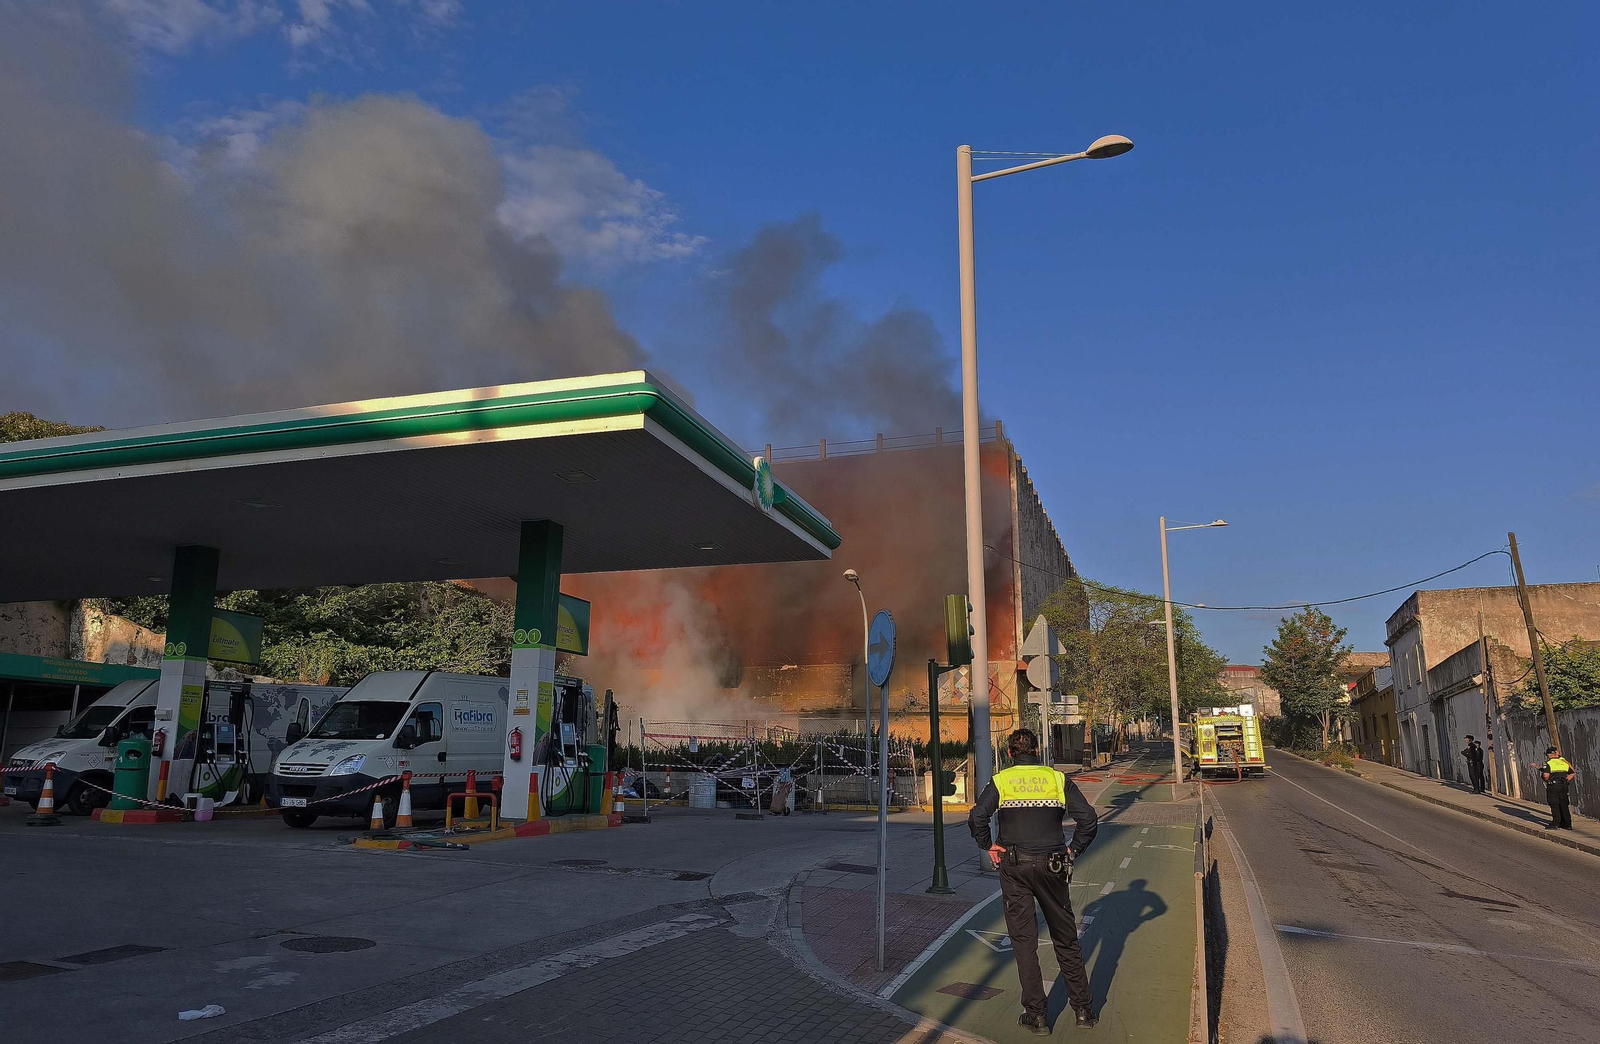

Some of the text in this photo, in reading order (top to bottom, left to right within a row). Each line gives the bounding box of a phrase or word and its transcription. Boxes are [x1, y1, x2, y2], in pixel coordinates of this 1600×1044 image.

[212, 635, 240, 647] Ultimate
[517, 632, 523, 641] 2
[42, 659, 74, 668] PROGRAMA
[58, 668, 88, 676] ACLARADO
[454, 708, 493, 724] Rafibra
[1008, 776, 1049, 785] POLICIA
[1013, 785, 1046, 793] LOCAL
